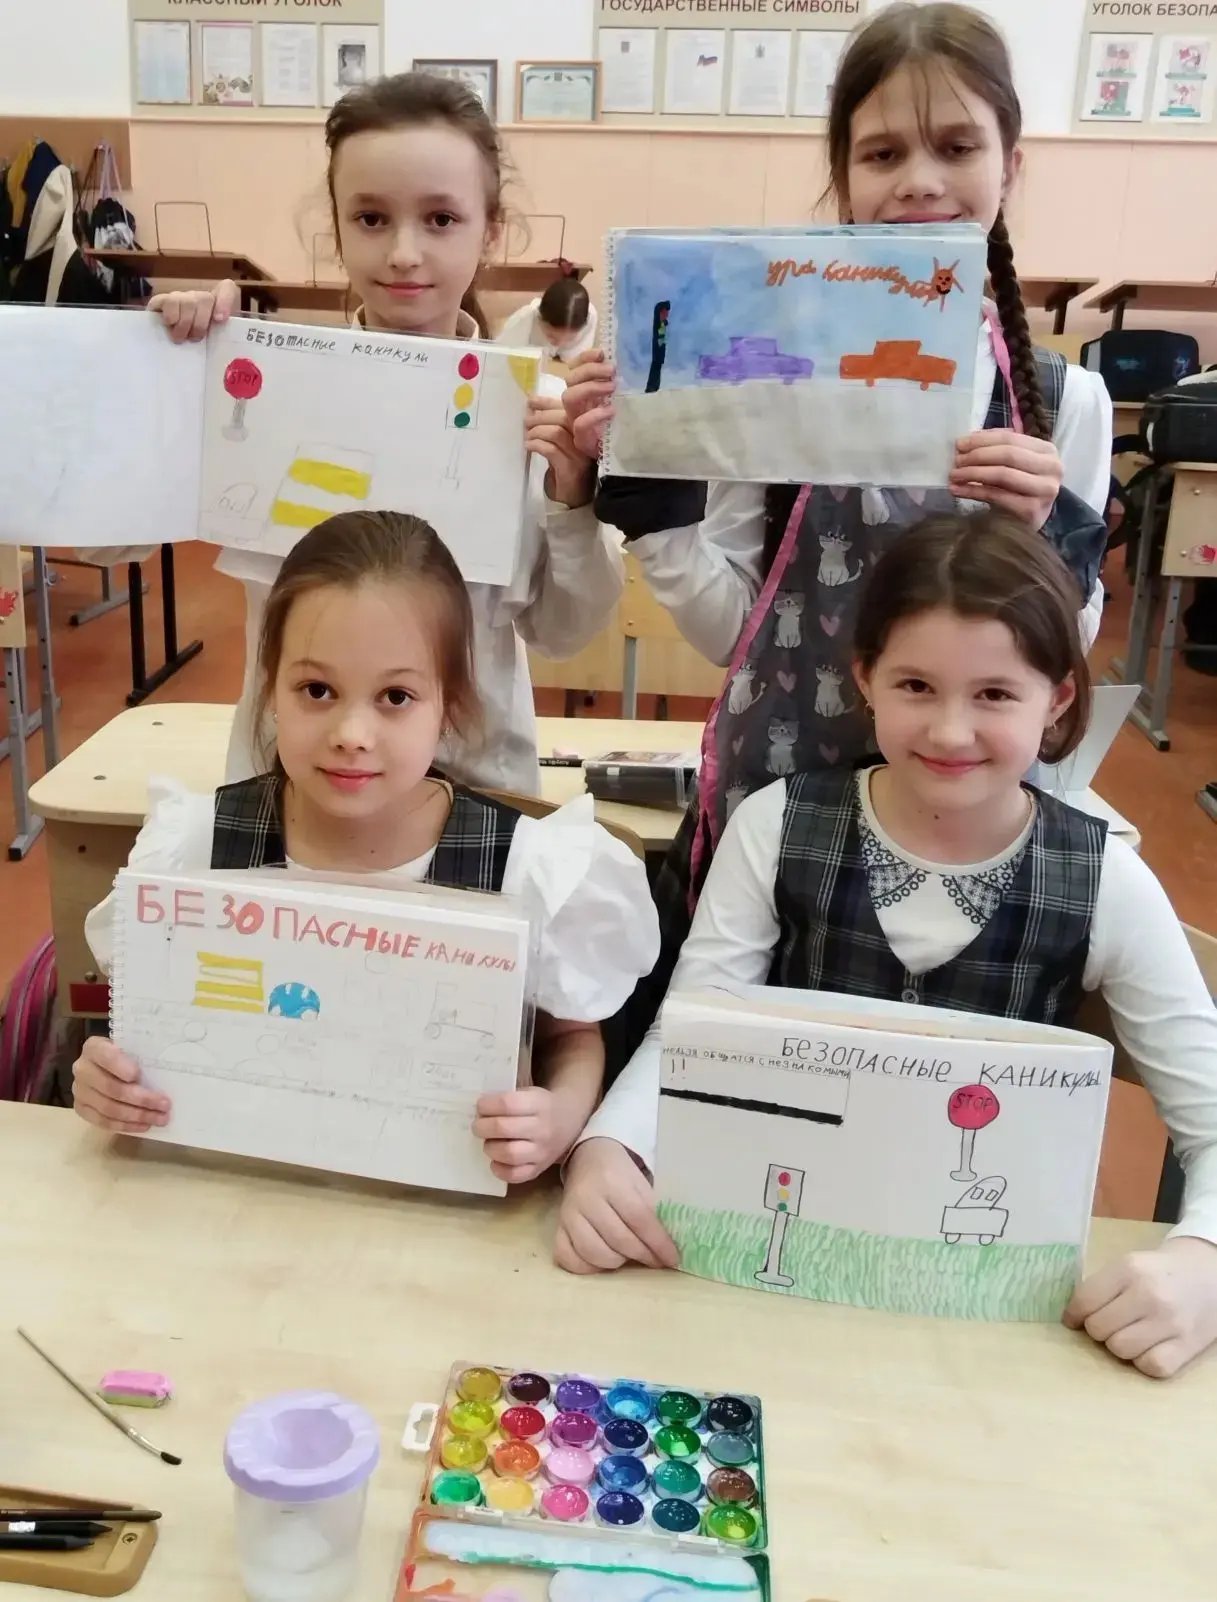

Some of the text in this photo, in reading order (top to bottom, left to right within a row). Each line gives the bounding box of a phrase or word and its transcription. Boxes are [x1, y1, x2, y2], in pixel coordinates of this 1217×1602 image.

[773, 0, 859, 13] СИМВОЛЫ
[1092, 3, 1153, 15] УГОЛОК
[953, 1093, 993, 1112] STOP
